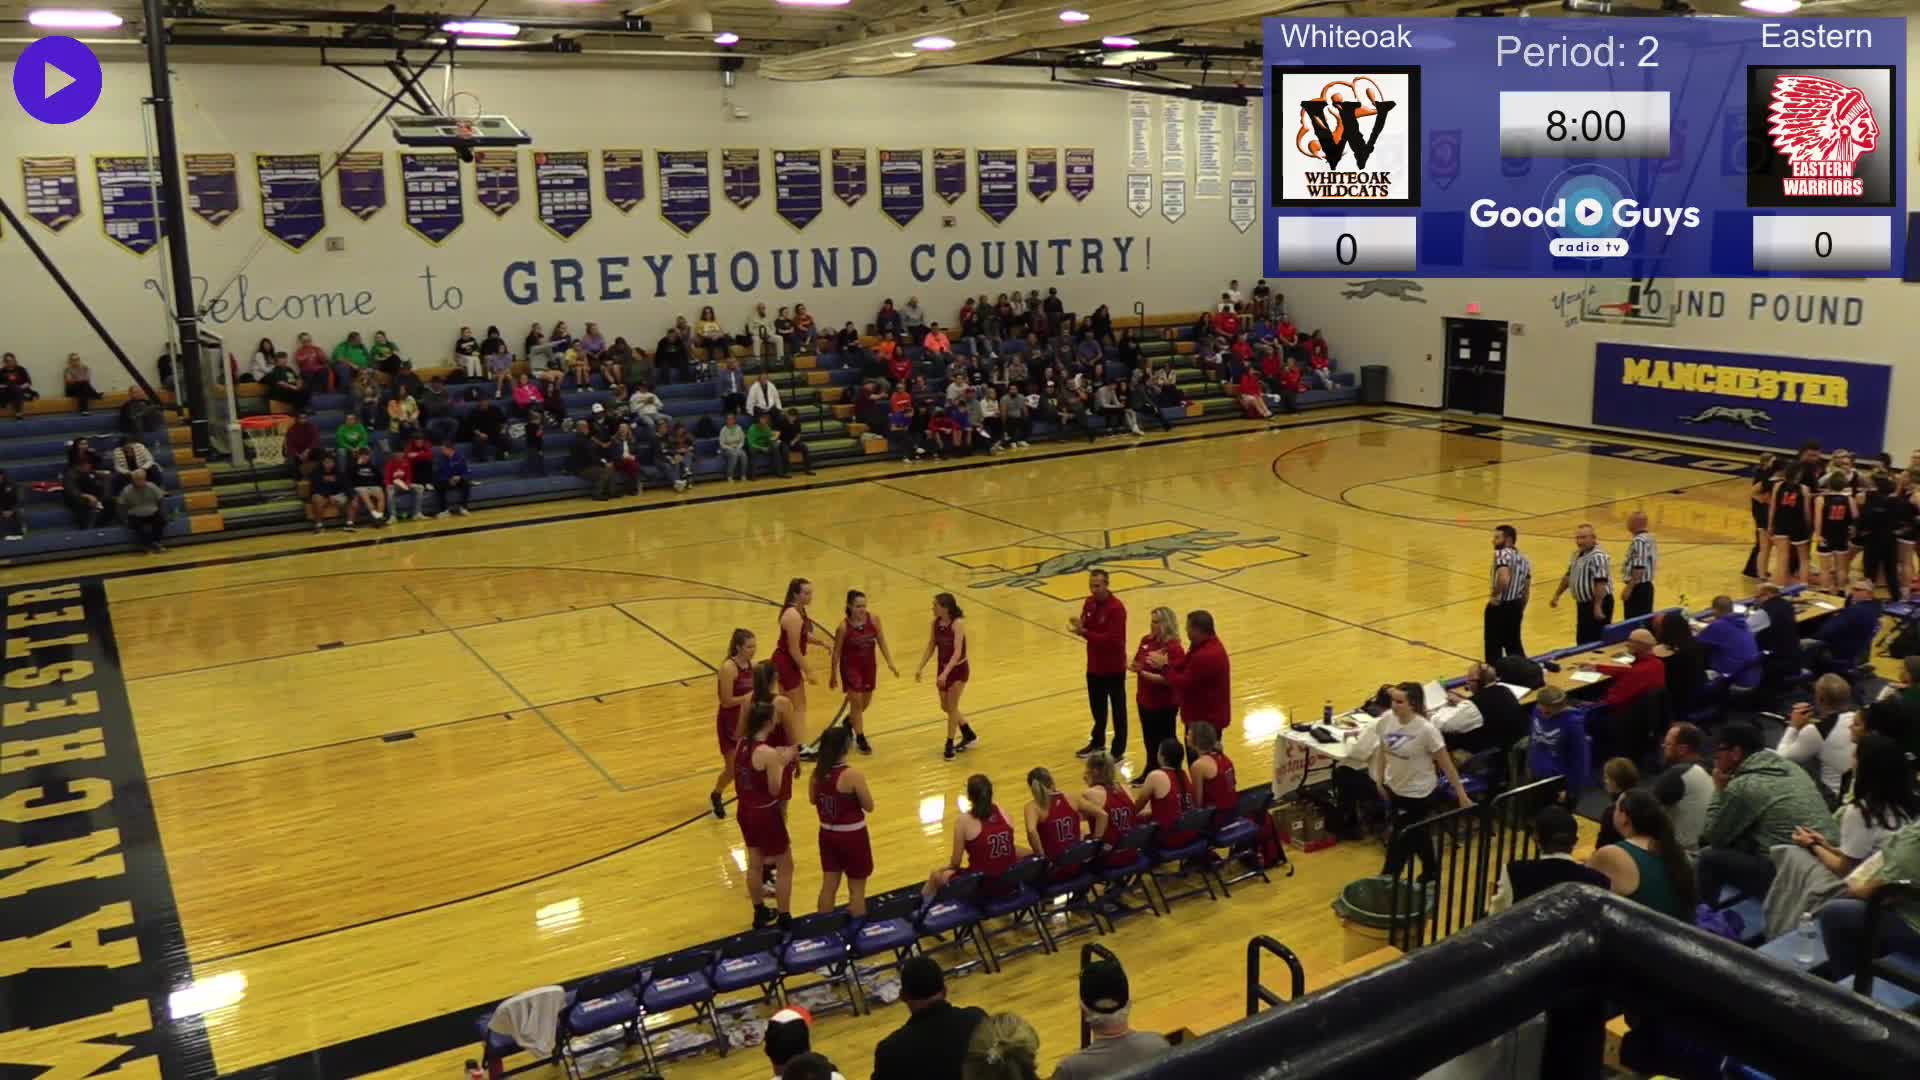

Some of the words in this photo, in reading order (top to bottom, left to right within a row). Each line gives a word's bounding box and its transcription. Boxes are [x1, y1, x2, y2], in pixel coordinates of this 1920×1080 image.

[418, 265, 463, 311] to
[503, 236, 879, 306] GREYHOUND
[910, 235, 1152, 283] COUNTRY!
[1749, 292, 1864, 327] POUND
[1623, 356, 1849, 408] MANCHESTER
